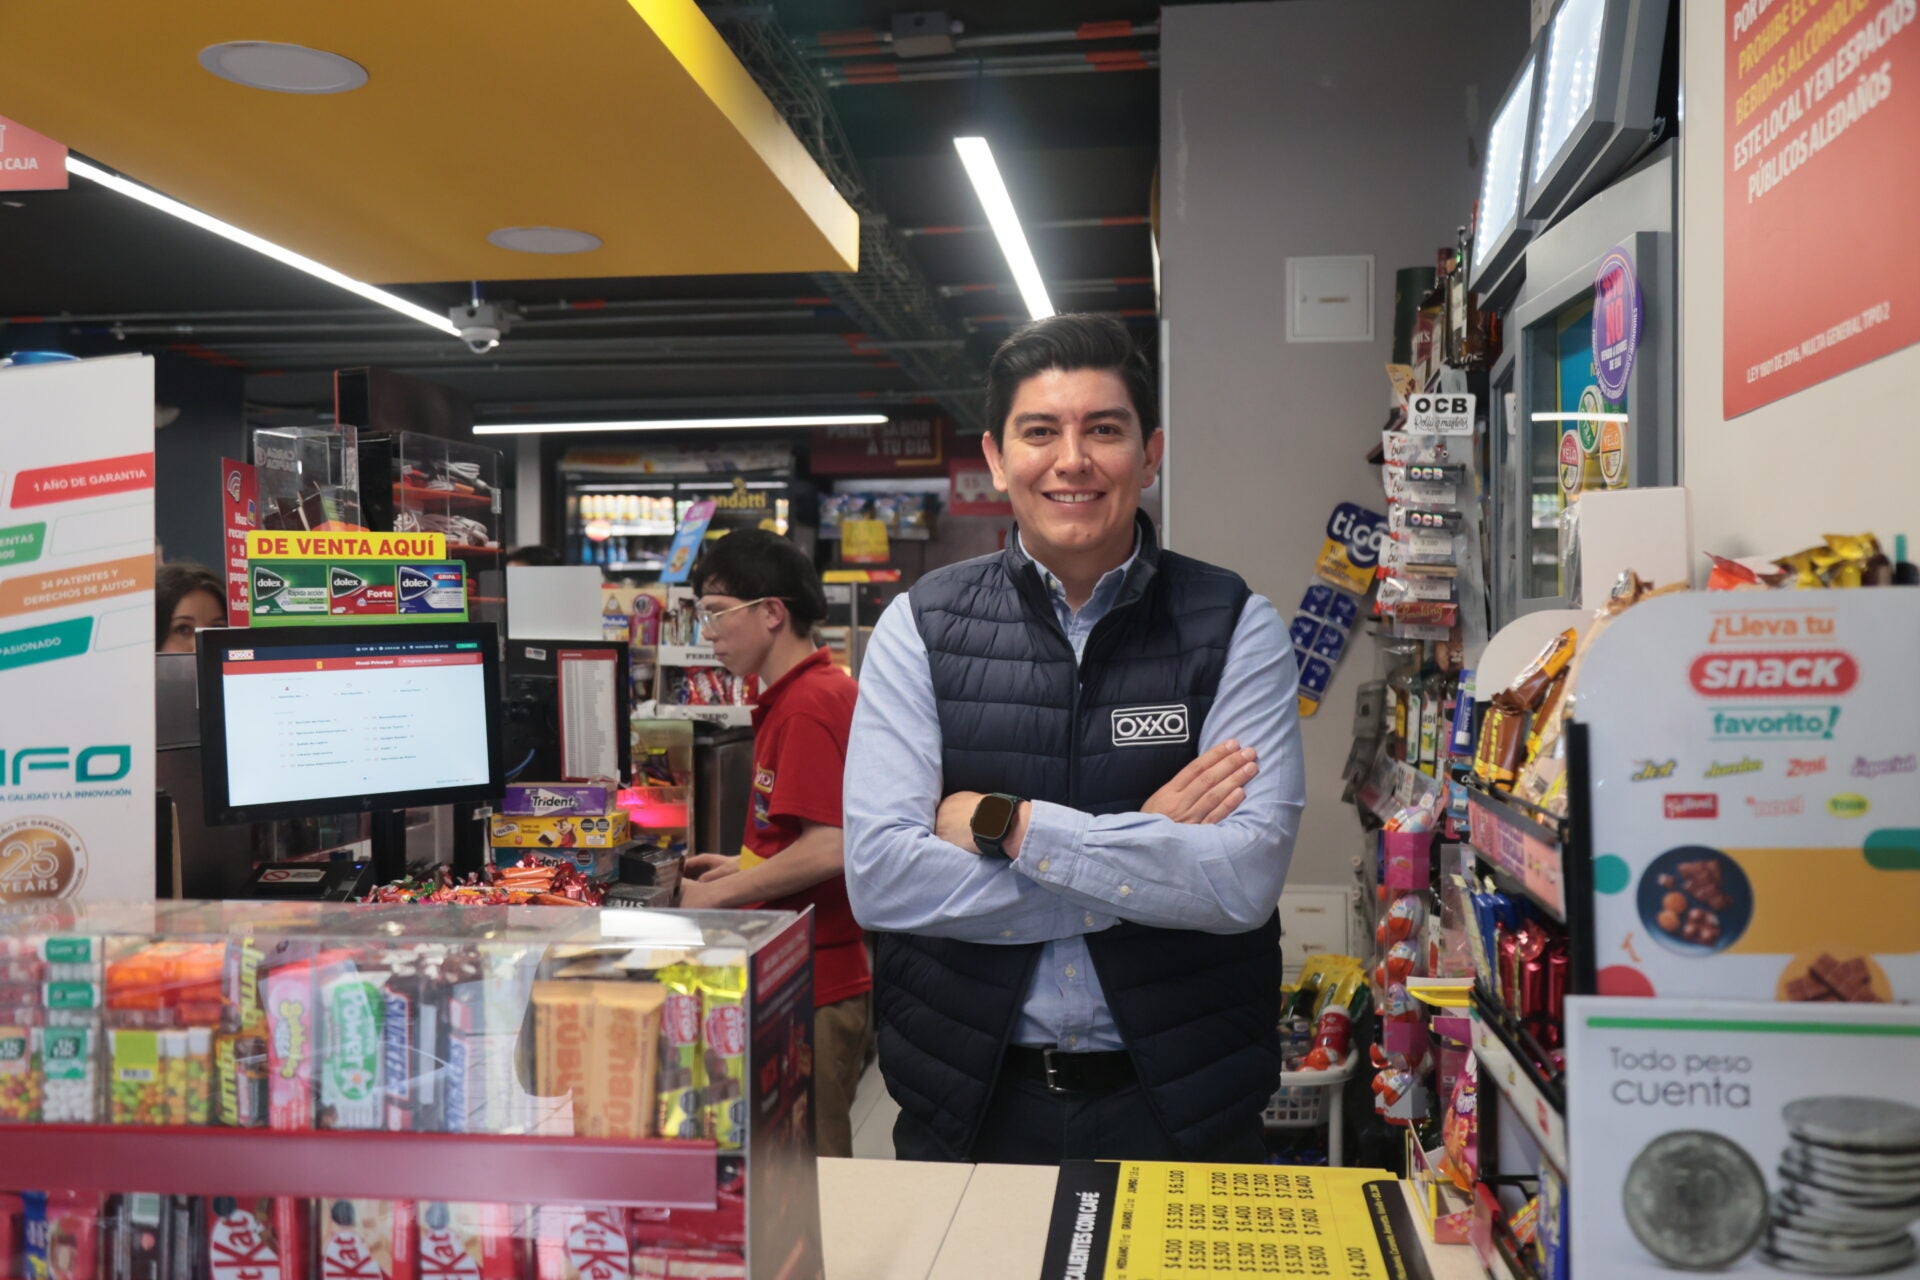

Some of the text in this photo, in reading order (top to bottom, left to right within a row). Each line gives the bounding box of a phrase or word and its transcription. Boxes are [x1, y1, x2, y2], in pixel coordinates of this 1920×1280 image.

[1734, 123, 1762, 172] ESTE
[1762, 88, 1804, 147] LOCAL
[1803, 74, 1815, 110] Y
[1814, 57, 1835, 102] EN
[1748, 60, 1892, 204] PÚBLICOS ALEDAÑOS
[4, 157, 39, 170] CAJA
[1415, 398, 1467, 414] OCB
[1411, 467, 1443, 480] OCB
[43, 477, 69, 492] AÑO
[71, 476, 87, 489] DE
[1410, 512, 1443, 527] OCB
[257, 534, 434, 557] DE VENTA AQUÍ
[56, 572, 108, 587] PATENTES
[110, 568, 119, 579] Y
[257, 578, 282, 588] dolex
[333, 578, 359, 587] dolex
[402, 578, 429, 588] dolex
[24, 578, 136, 606] DERECHOS DE AUTOR
[366, 590, 394, 598] Forte
[1805, 613, 1835, 636] tu
[1701, 656, 1844, 690] snack
[1115, 711, 1186, 739] OXXO
[1713, 706, 1842, 739] favorito!
[8, 792, 50, 802] CALIDAD
[60, 790, 73, 799] LA
[74, 787, 132, 799] INNOVACIÓN
[533, 796, 575, 807] Trident
[1, 839, 60, 880] 25
[0, 879, 59, 893] YEARS
[386, 998, 407, 1096] SNICKERS
[1610, 1048, 1752, 1076] Todo peso
[1612, 1077, 1752, 1108] cuenta
[1076, 1191, 1100, 1213] CAFÉ
[1074, 1212, 1097, 1232] CON
